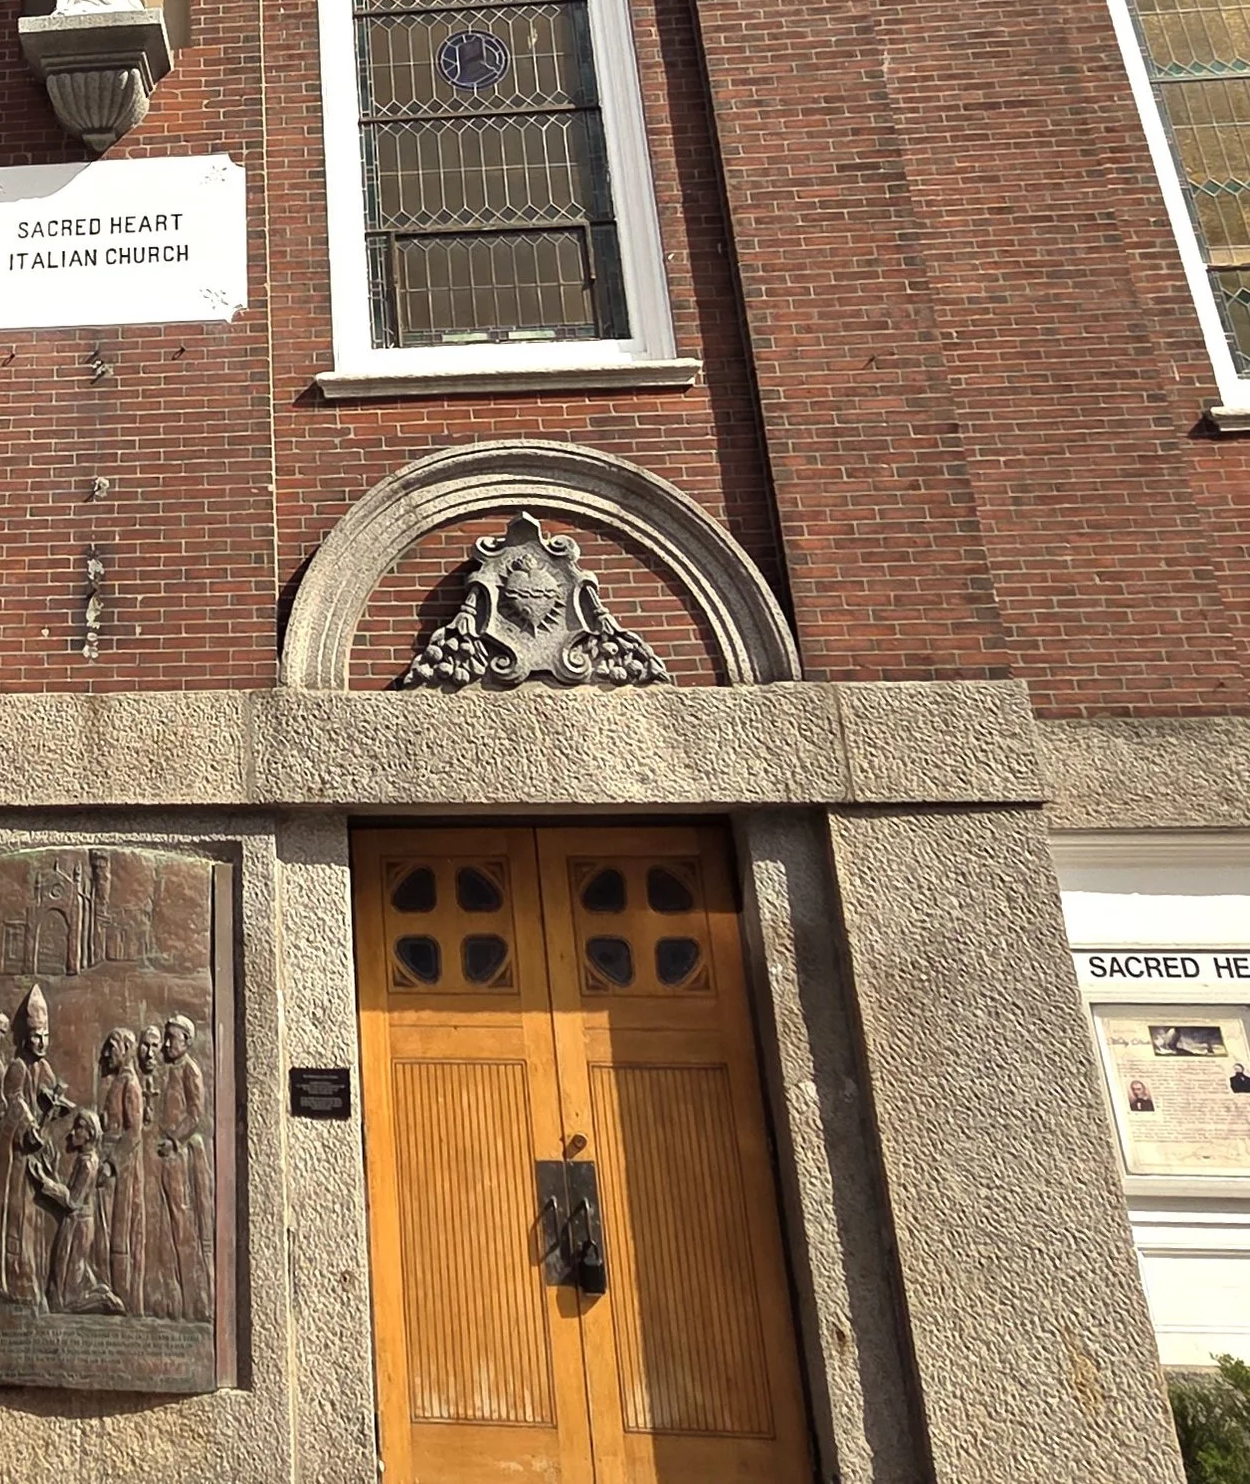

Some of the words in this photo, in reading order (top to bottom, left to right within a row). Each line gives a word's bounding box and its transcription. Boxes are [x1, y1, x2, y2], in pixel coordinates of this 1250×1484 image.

[17, 218, 101, 238] SACRED
[110, 214, 182, 234] HEART
[9, 249, 98, 271] ITALIAN
[105, 244, 189, 265] CHURCH
[1088, 956, 1200, 978] SACRED
[1213, 956, 1250, 979] HE
